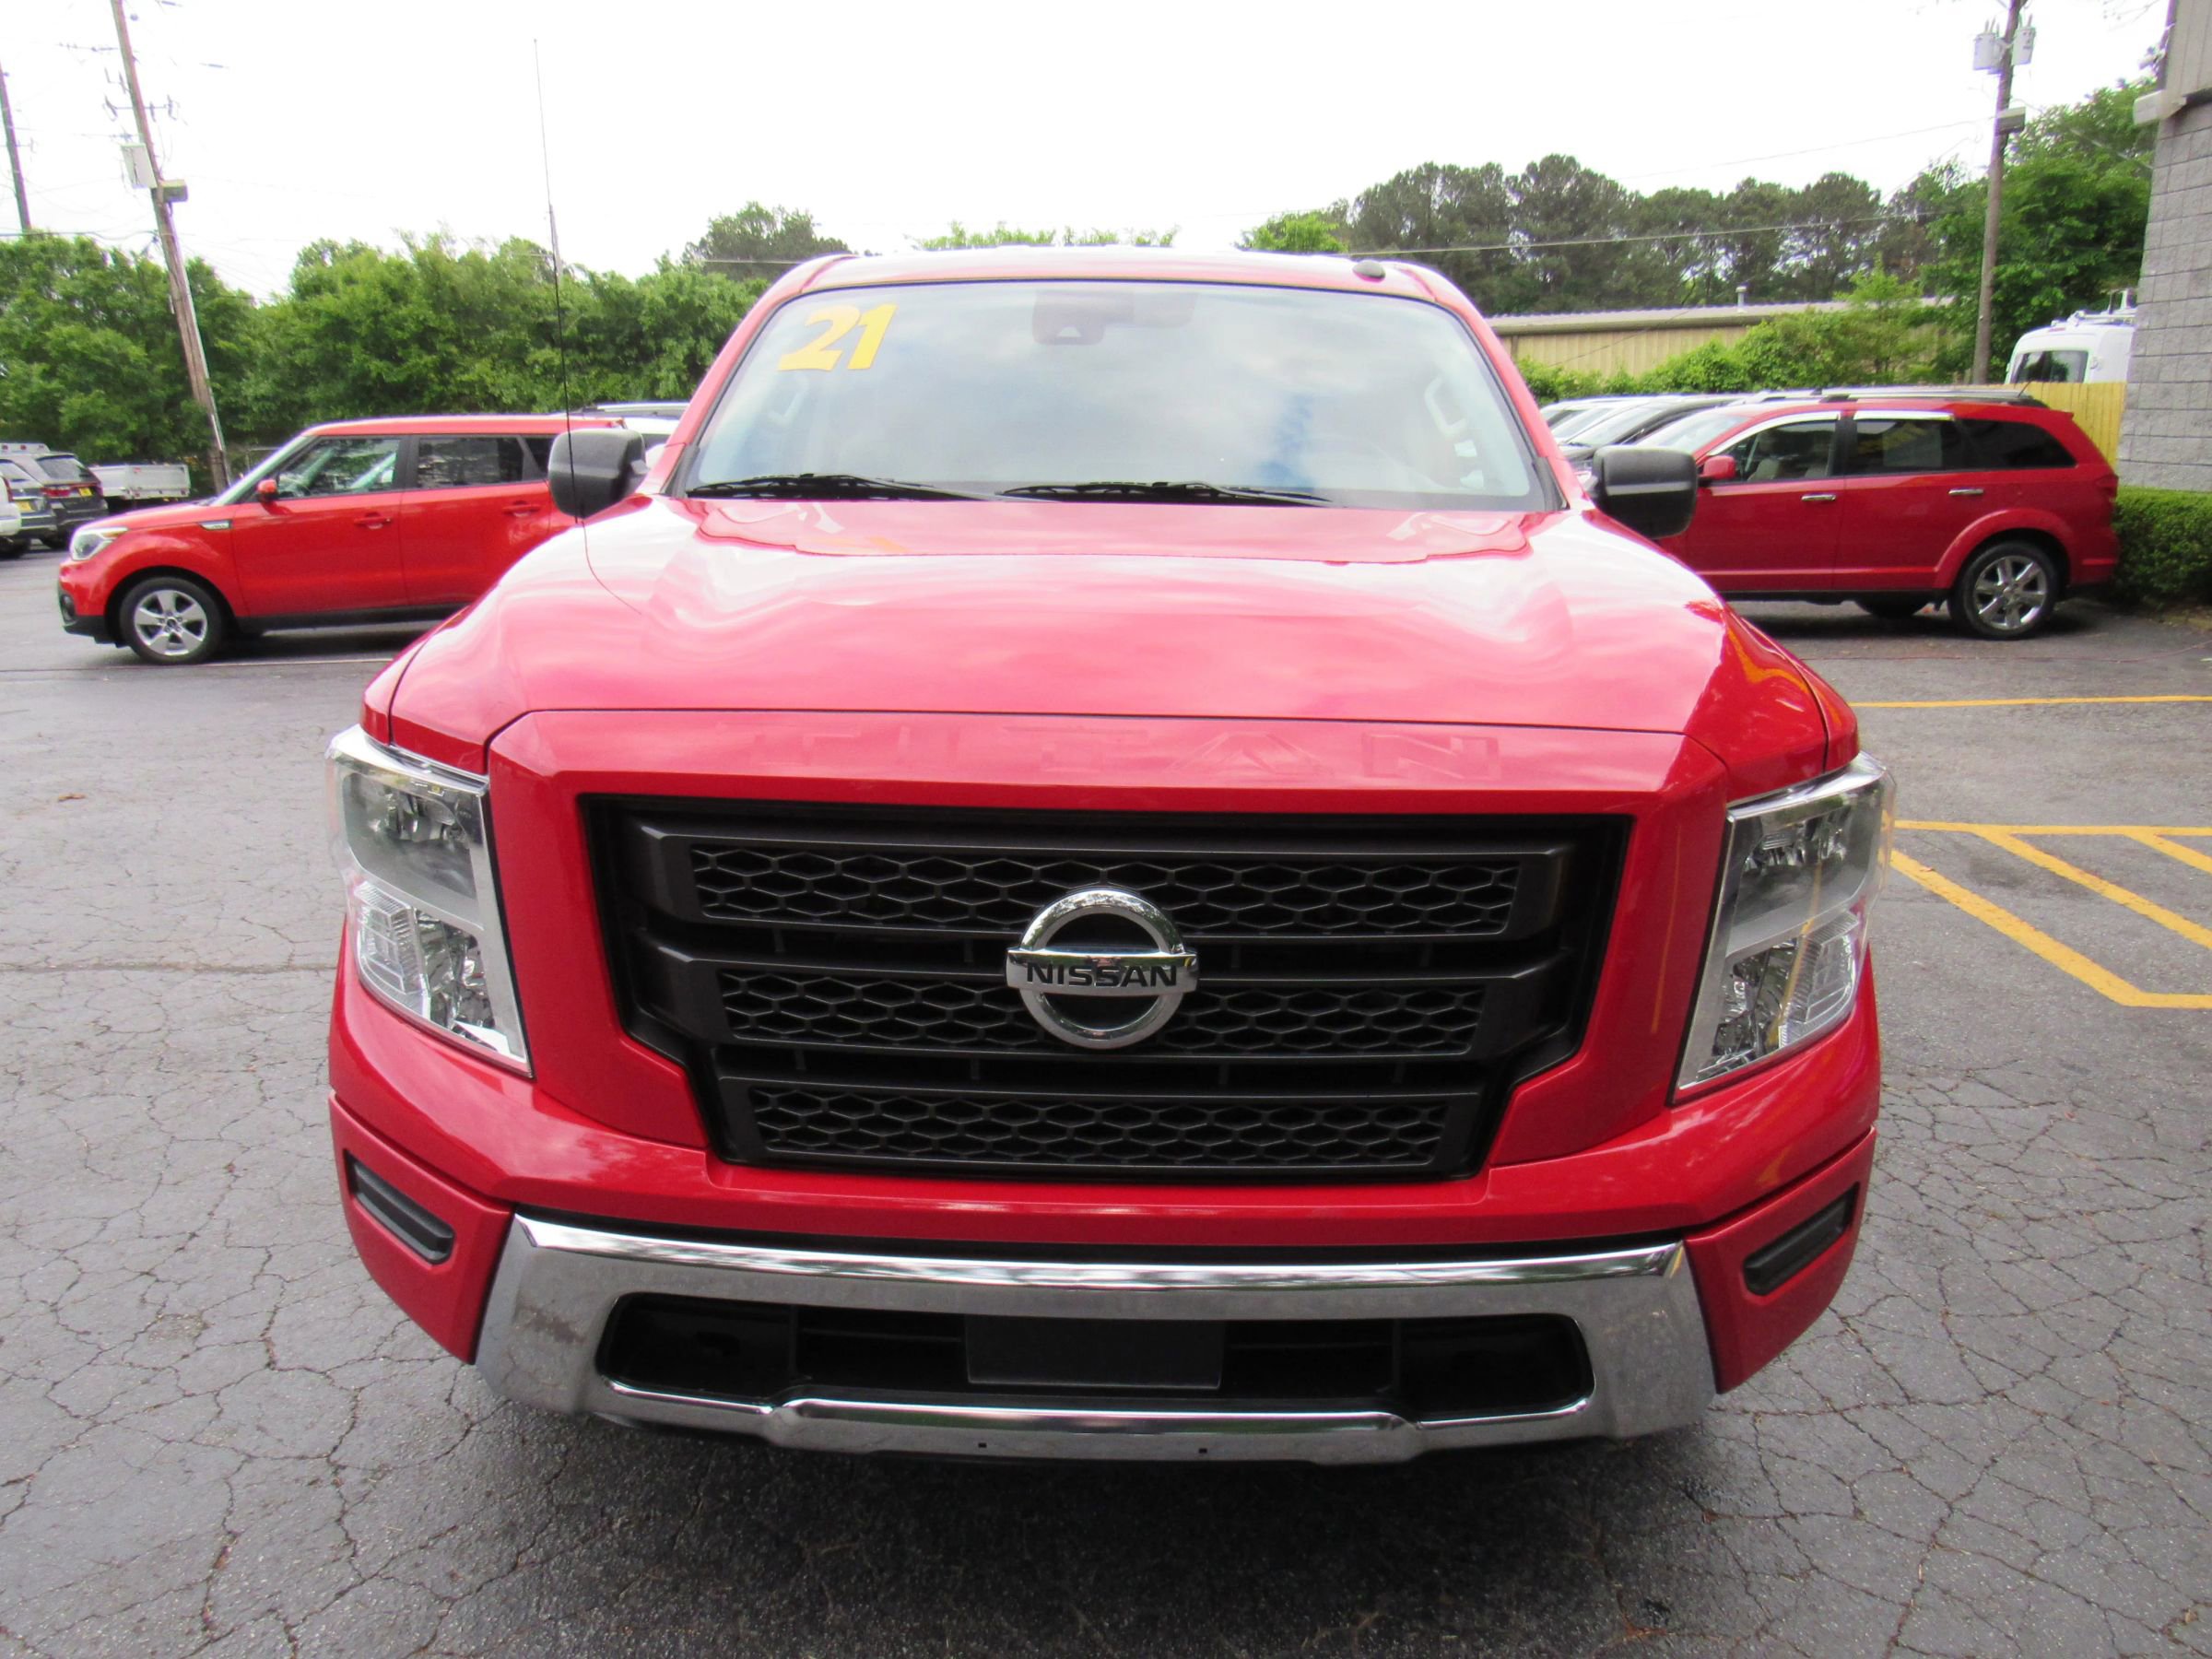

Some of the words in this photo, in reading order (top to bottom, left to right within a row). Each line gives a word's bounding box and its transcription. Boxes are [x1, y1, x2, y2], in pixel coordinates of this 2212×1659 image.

[778, 303, 898, 371] 21
[715, 722, 1502, 781] TITAN
[1026, 964, 1177, 988] NISSAN
